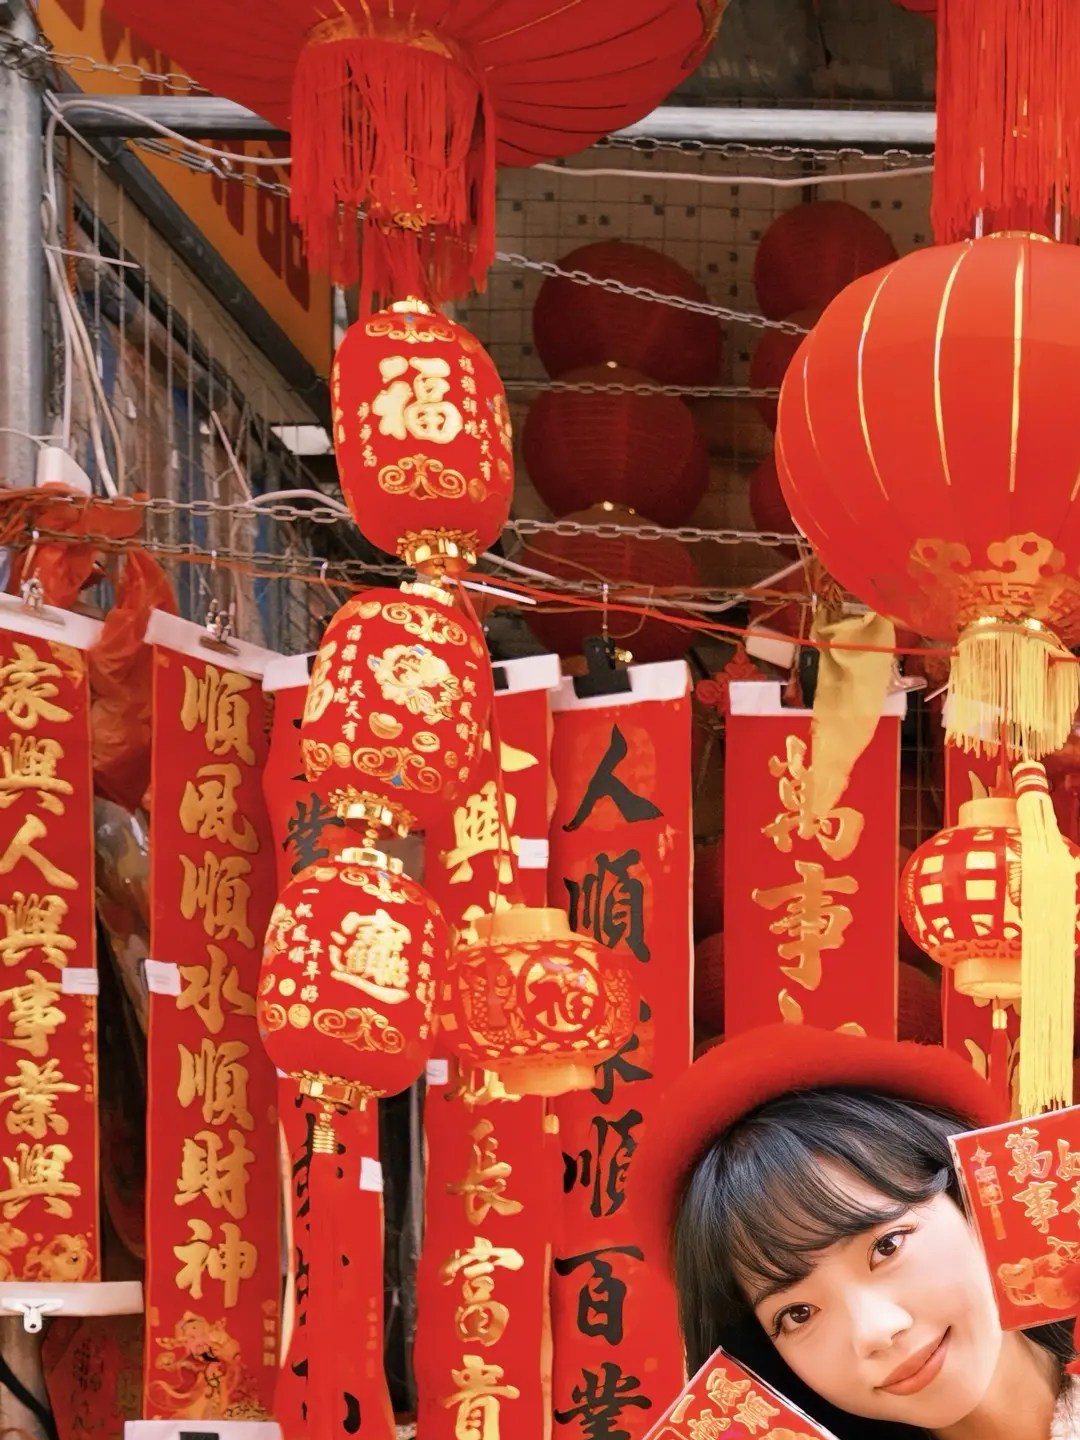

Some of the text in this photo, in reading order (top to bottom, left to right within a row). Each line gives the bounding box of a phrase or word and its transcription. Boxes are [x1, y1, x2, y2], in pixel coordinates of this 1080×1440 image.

[372, 355, 464, 444] 福
[0, 642, 82, 1218] 家興人興事業興
[173, 664, 260, 1309] 順風順水順財神
[752, 735, 867, 1038] 萬事
